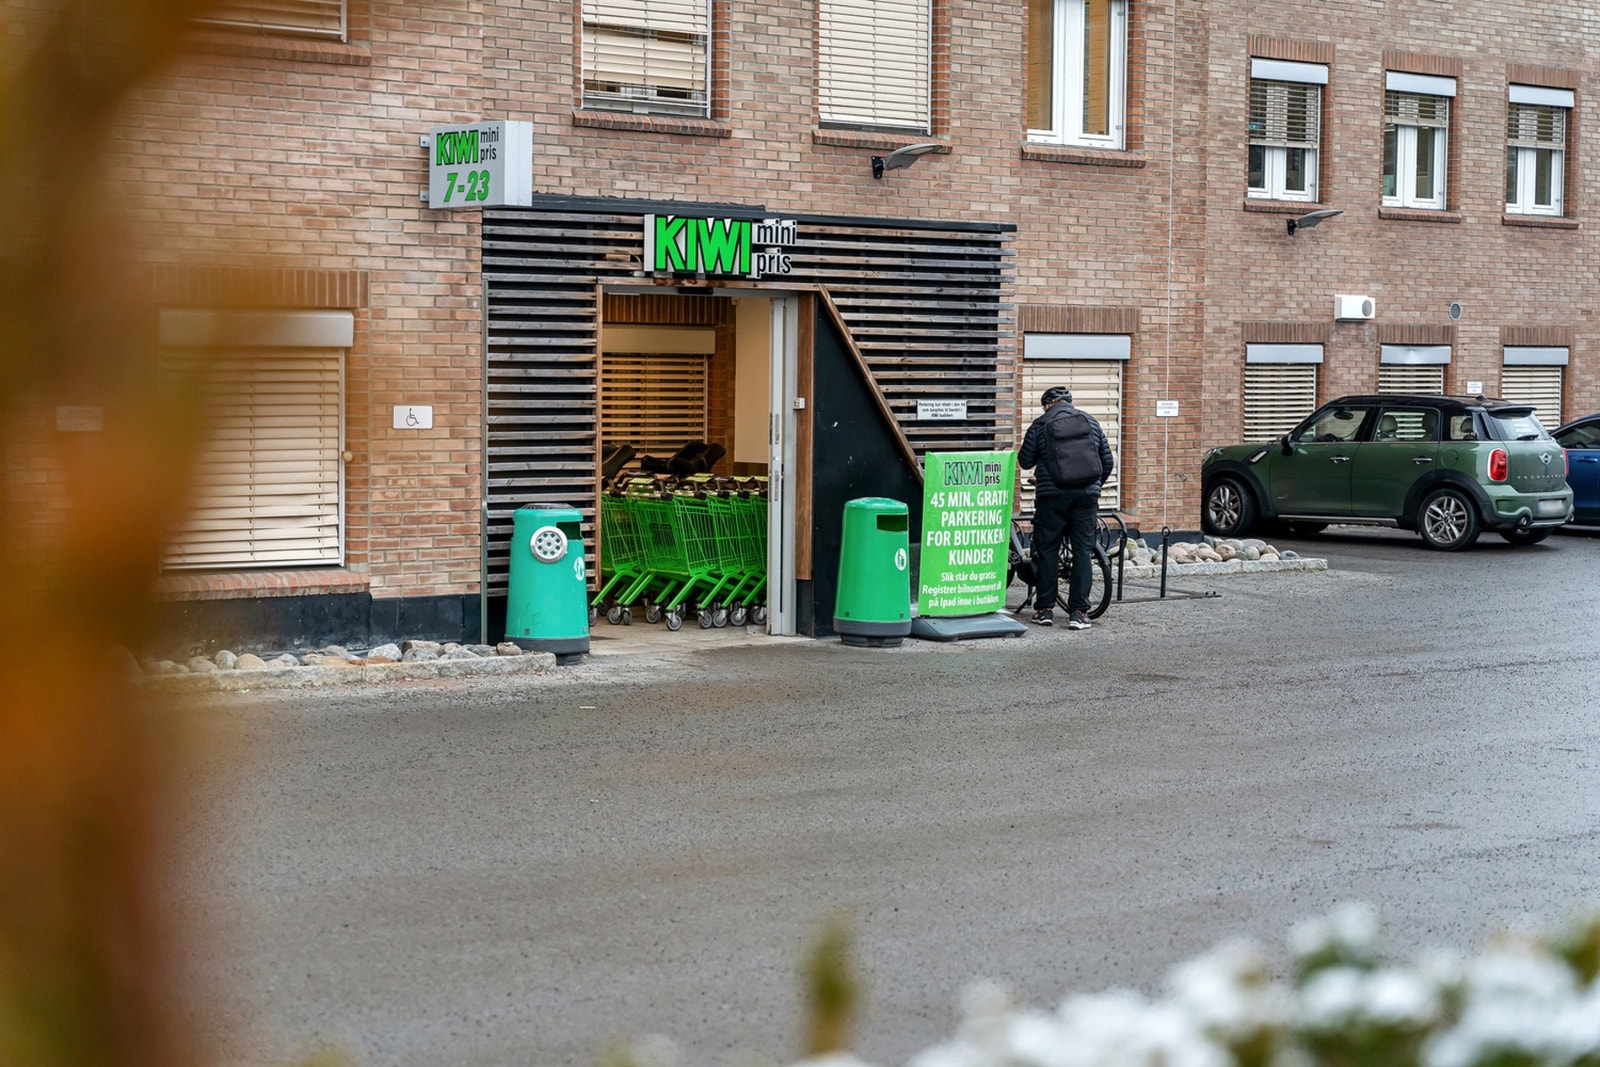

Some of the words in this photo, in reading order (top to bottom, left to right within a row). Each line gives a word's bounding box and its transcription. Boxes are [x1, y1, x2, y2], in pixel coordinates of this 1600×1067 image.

[436, 129, 479, 166] KIWI
[480, 126, 499, 143] mini
[480, 144, 497, 164] pris
[443, 169, 490, 202] 7-23
[655, 215, 752, 275] KIWI
[757, 218, 796, 245] mini
[757, 248, 791, 278] pris
[944, 461, 984, 486] KIWI
[984, 461, 1002, 473] mini
[984, 473, 1001, 487] pris
[930, 492, 945, 508] 45
[947, 491, 975, 508] MIN.
[941, 509, 1002, 528] PARKERING
[926, 530, 951, 547] FOR
[948, 548, 994, 566] KUNDER
